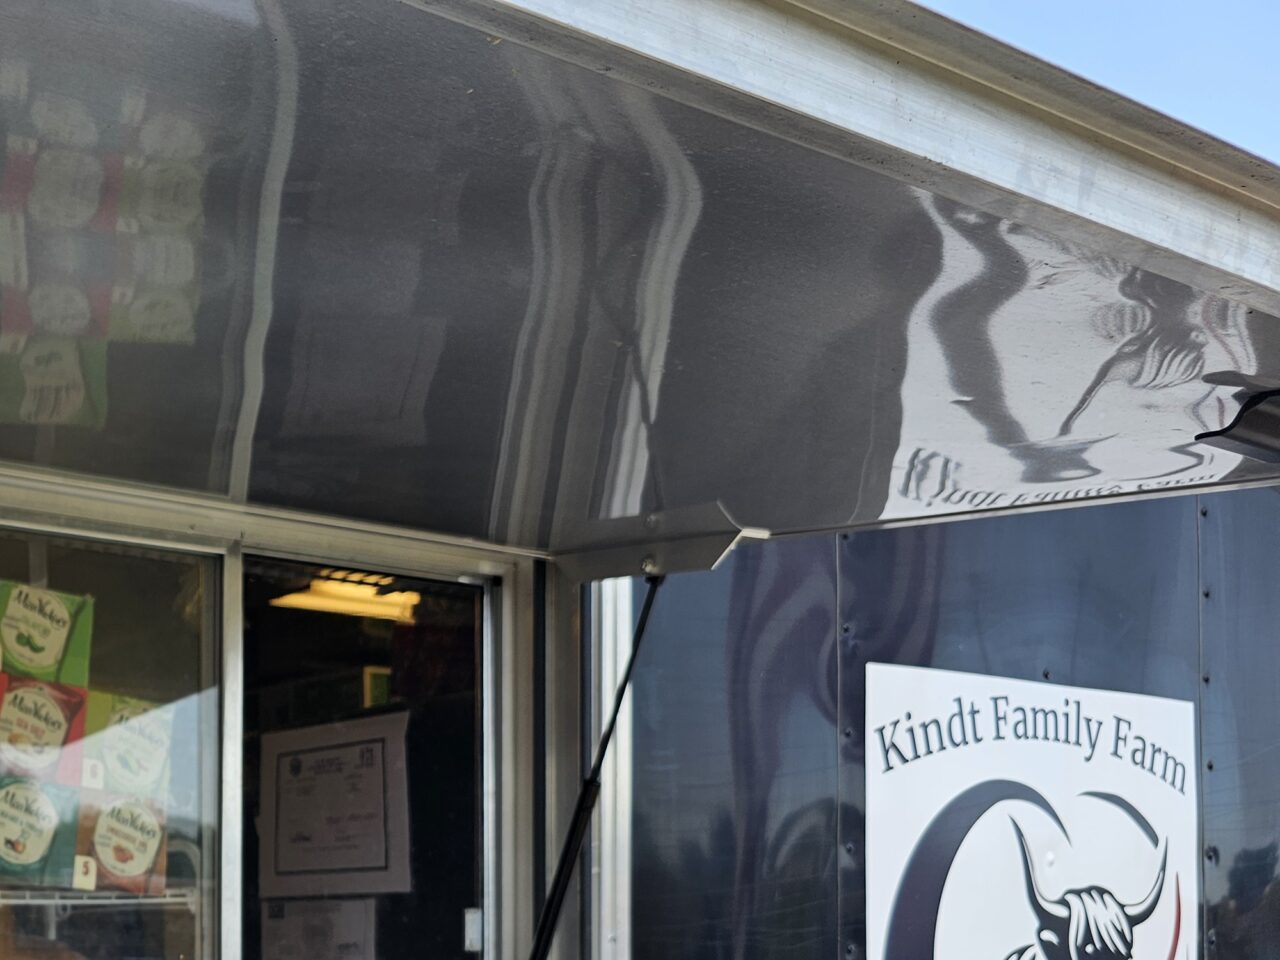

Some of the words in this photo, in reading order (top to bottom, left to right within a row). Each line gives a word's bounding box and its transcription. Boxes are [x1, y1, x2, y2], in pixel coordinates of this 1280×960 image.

[873, 696, 984, 774] Kindt
[989, 695, 1103, 763] Family
[1110, 714, 1187, 796] Farm
